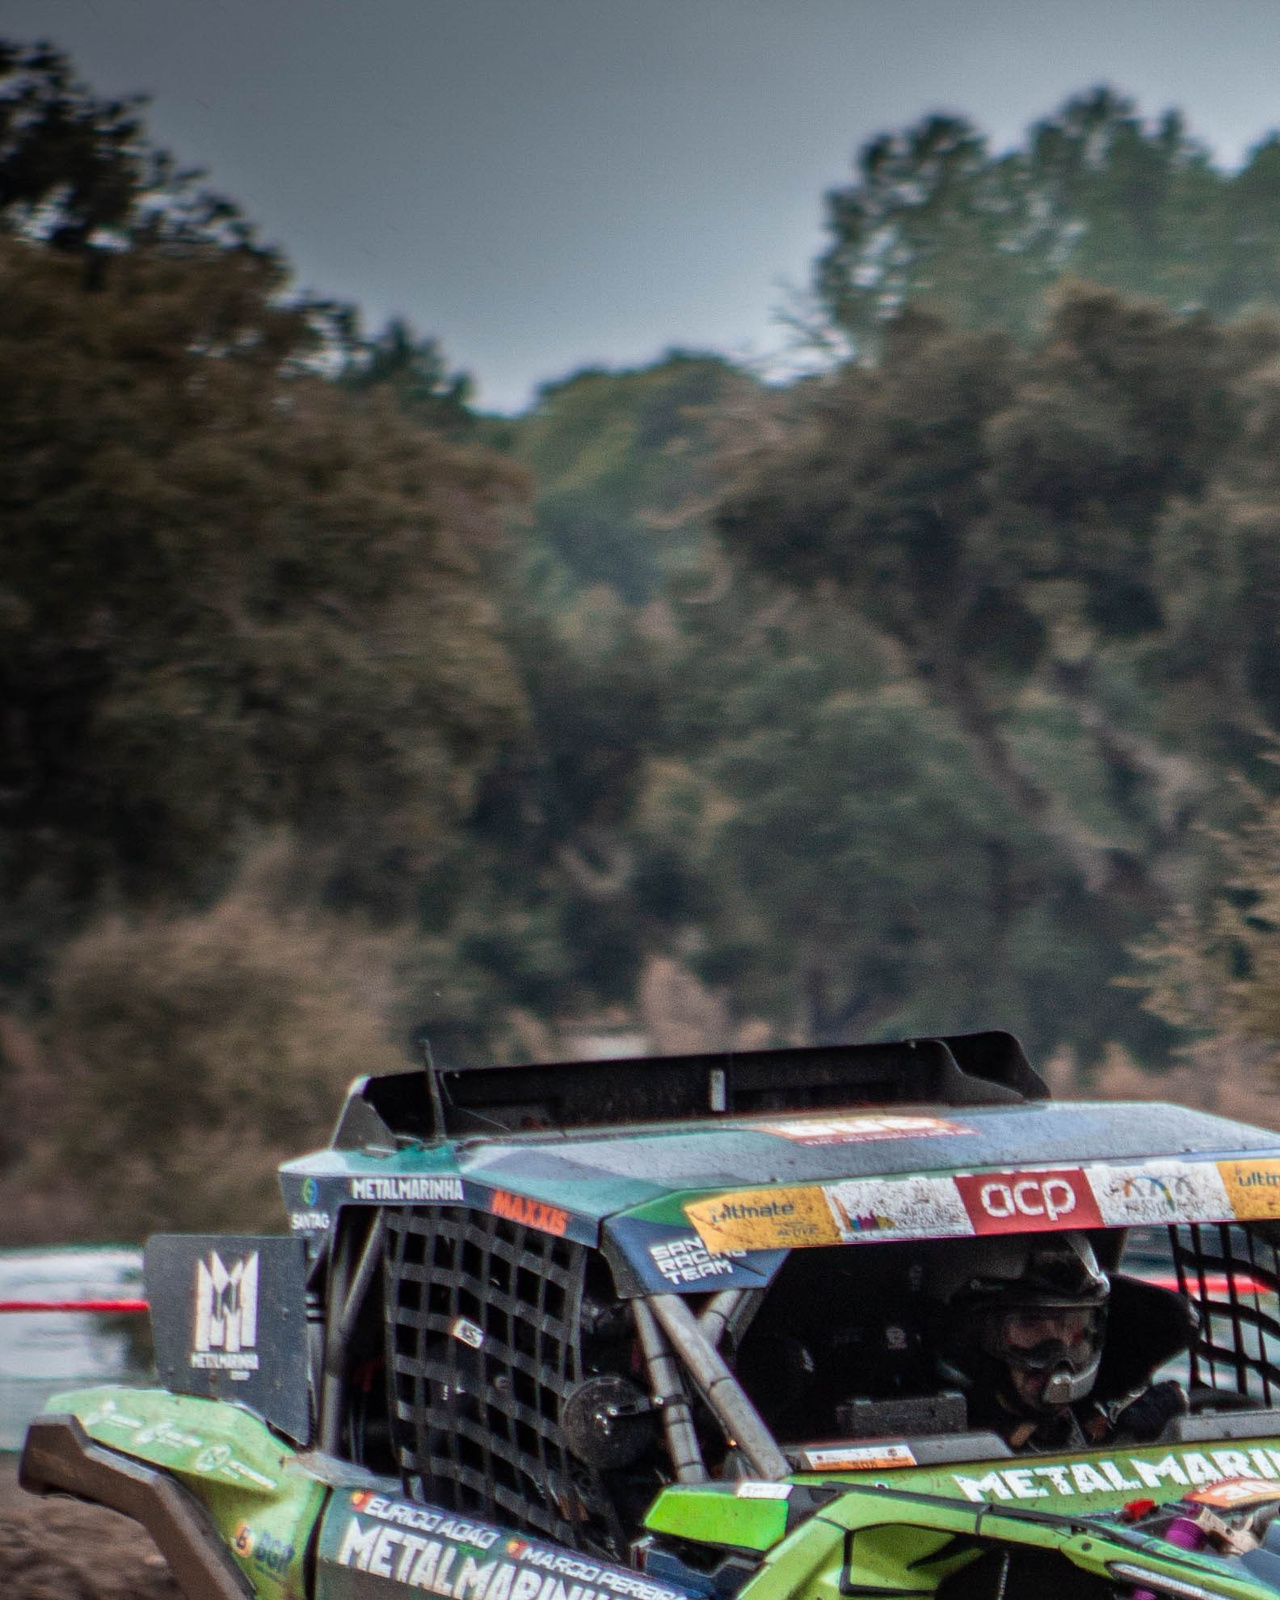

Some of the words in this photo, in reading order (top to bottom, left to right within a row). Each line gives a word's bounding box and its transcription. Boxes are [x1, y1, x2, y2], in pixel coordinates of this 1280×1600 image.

[352, 1178, 464, 1200] METALMARINHA
[981, 1179, 1076, 1221] acp
[492, 1189, 568, 1237] MAXXIS
[664, 1258, 734, 1286] TEAM
[363, 1496, 444, 1533] EURICO
[519, 1546, 602, 1583] MARCO
